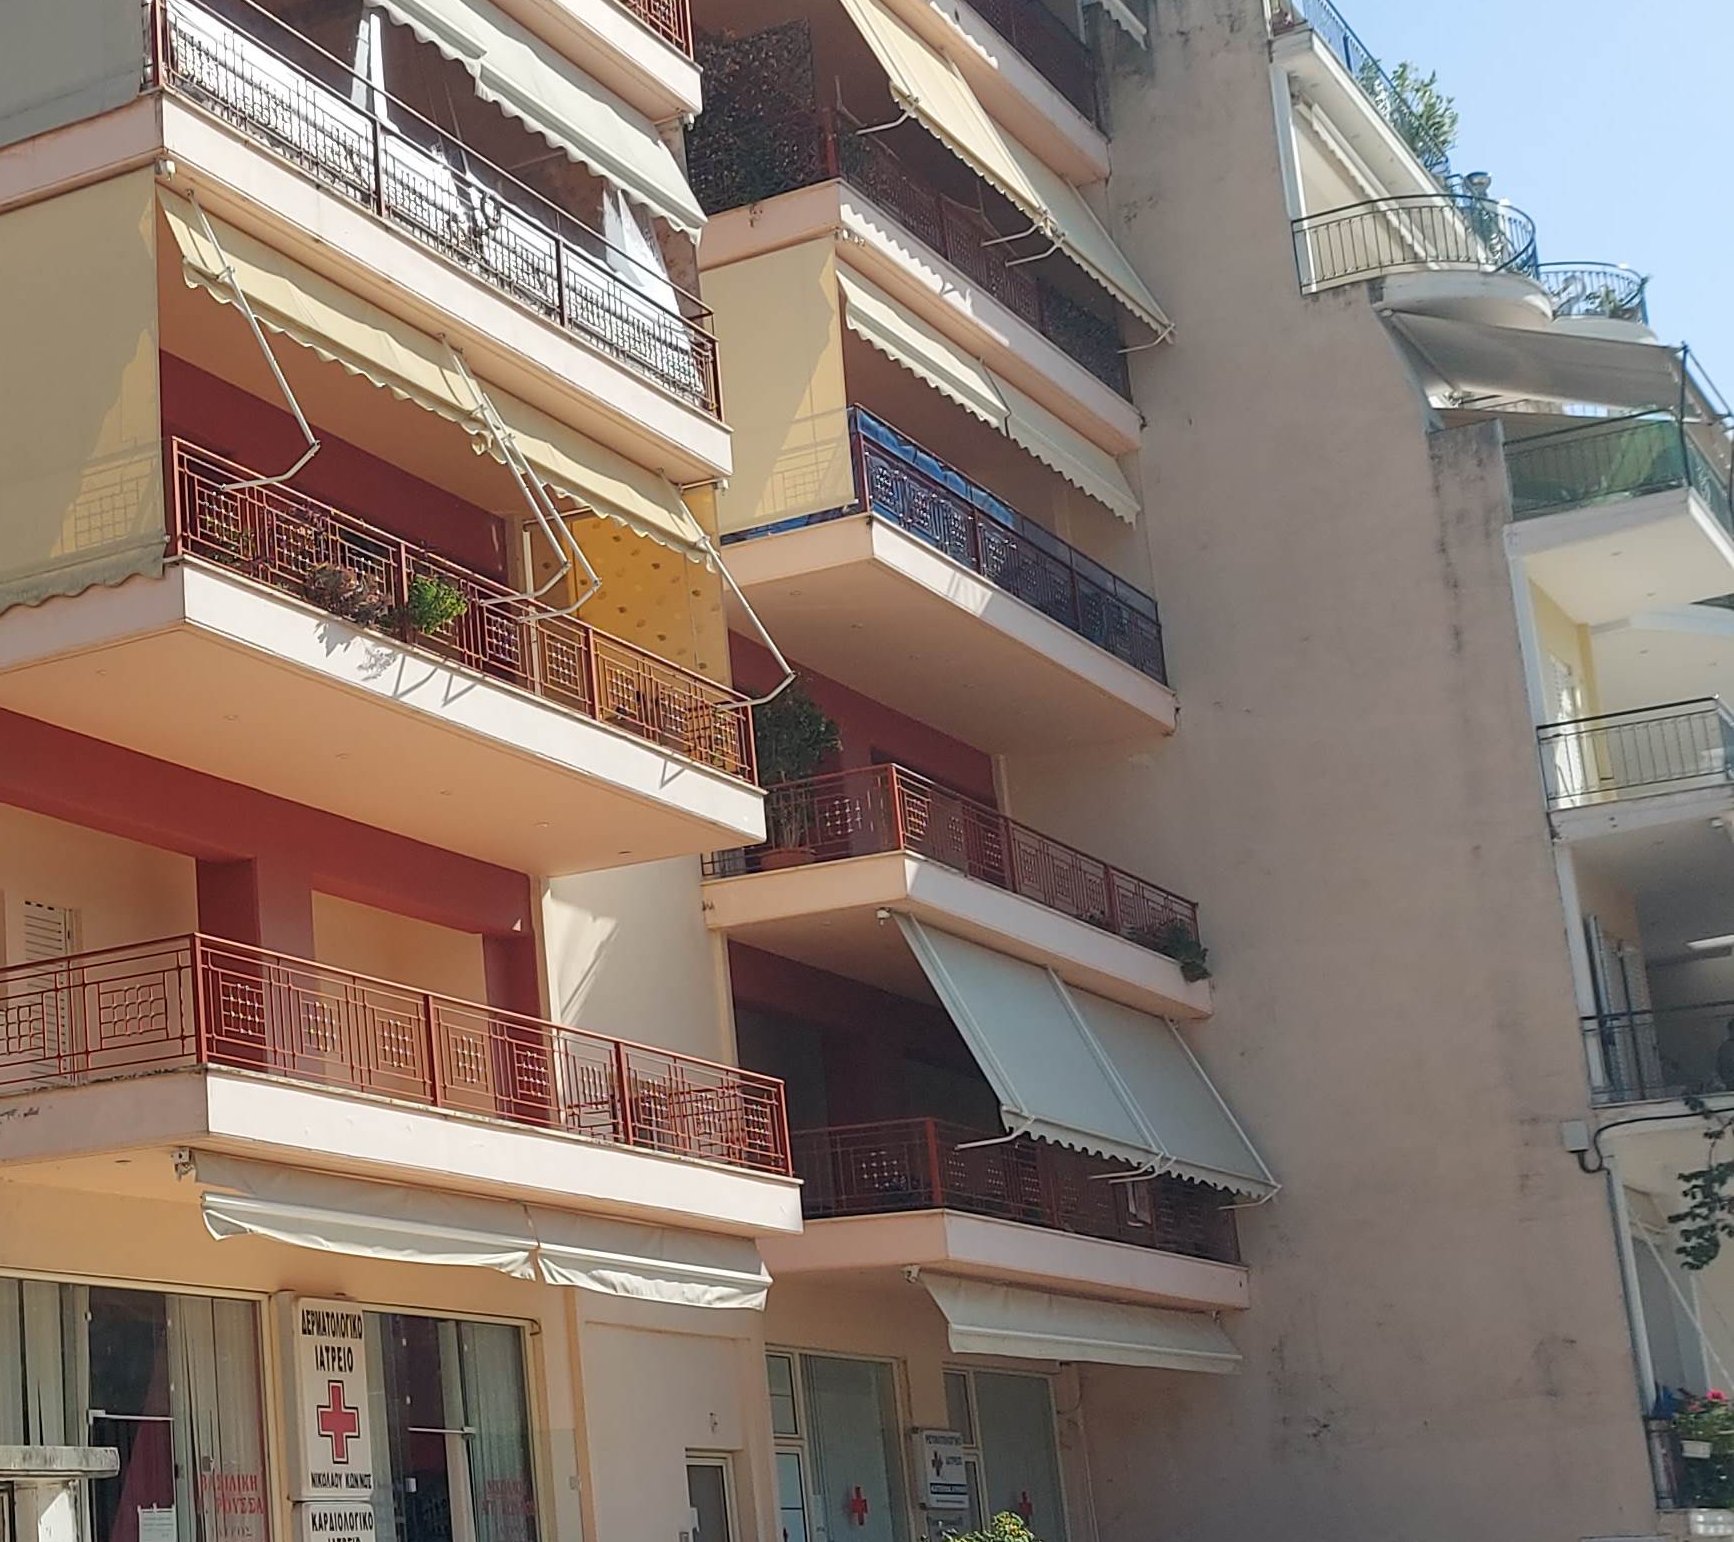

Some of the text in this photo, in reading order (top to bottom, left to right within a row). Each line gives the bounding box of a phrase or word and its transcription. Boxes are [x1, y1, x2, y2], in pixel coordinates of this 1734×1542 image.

[302, 1308, 363, 1339] ΔΕΡΜΑΤΟΛΟΓΙΚΟ
[314, 1344, 354, 1373] ΙΑΤΡΕΙΟ
[311, 1512, 374, 1532] ΚΑΡΔΙΟΛΟΓΙΚΟ
